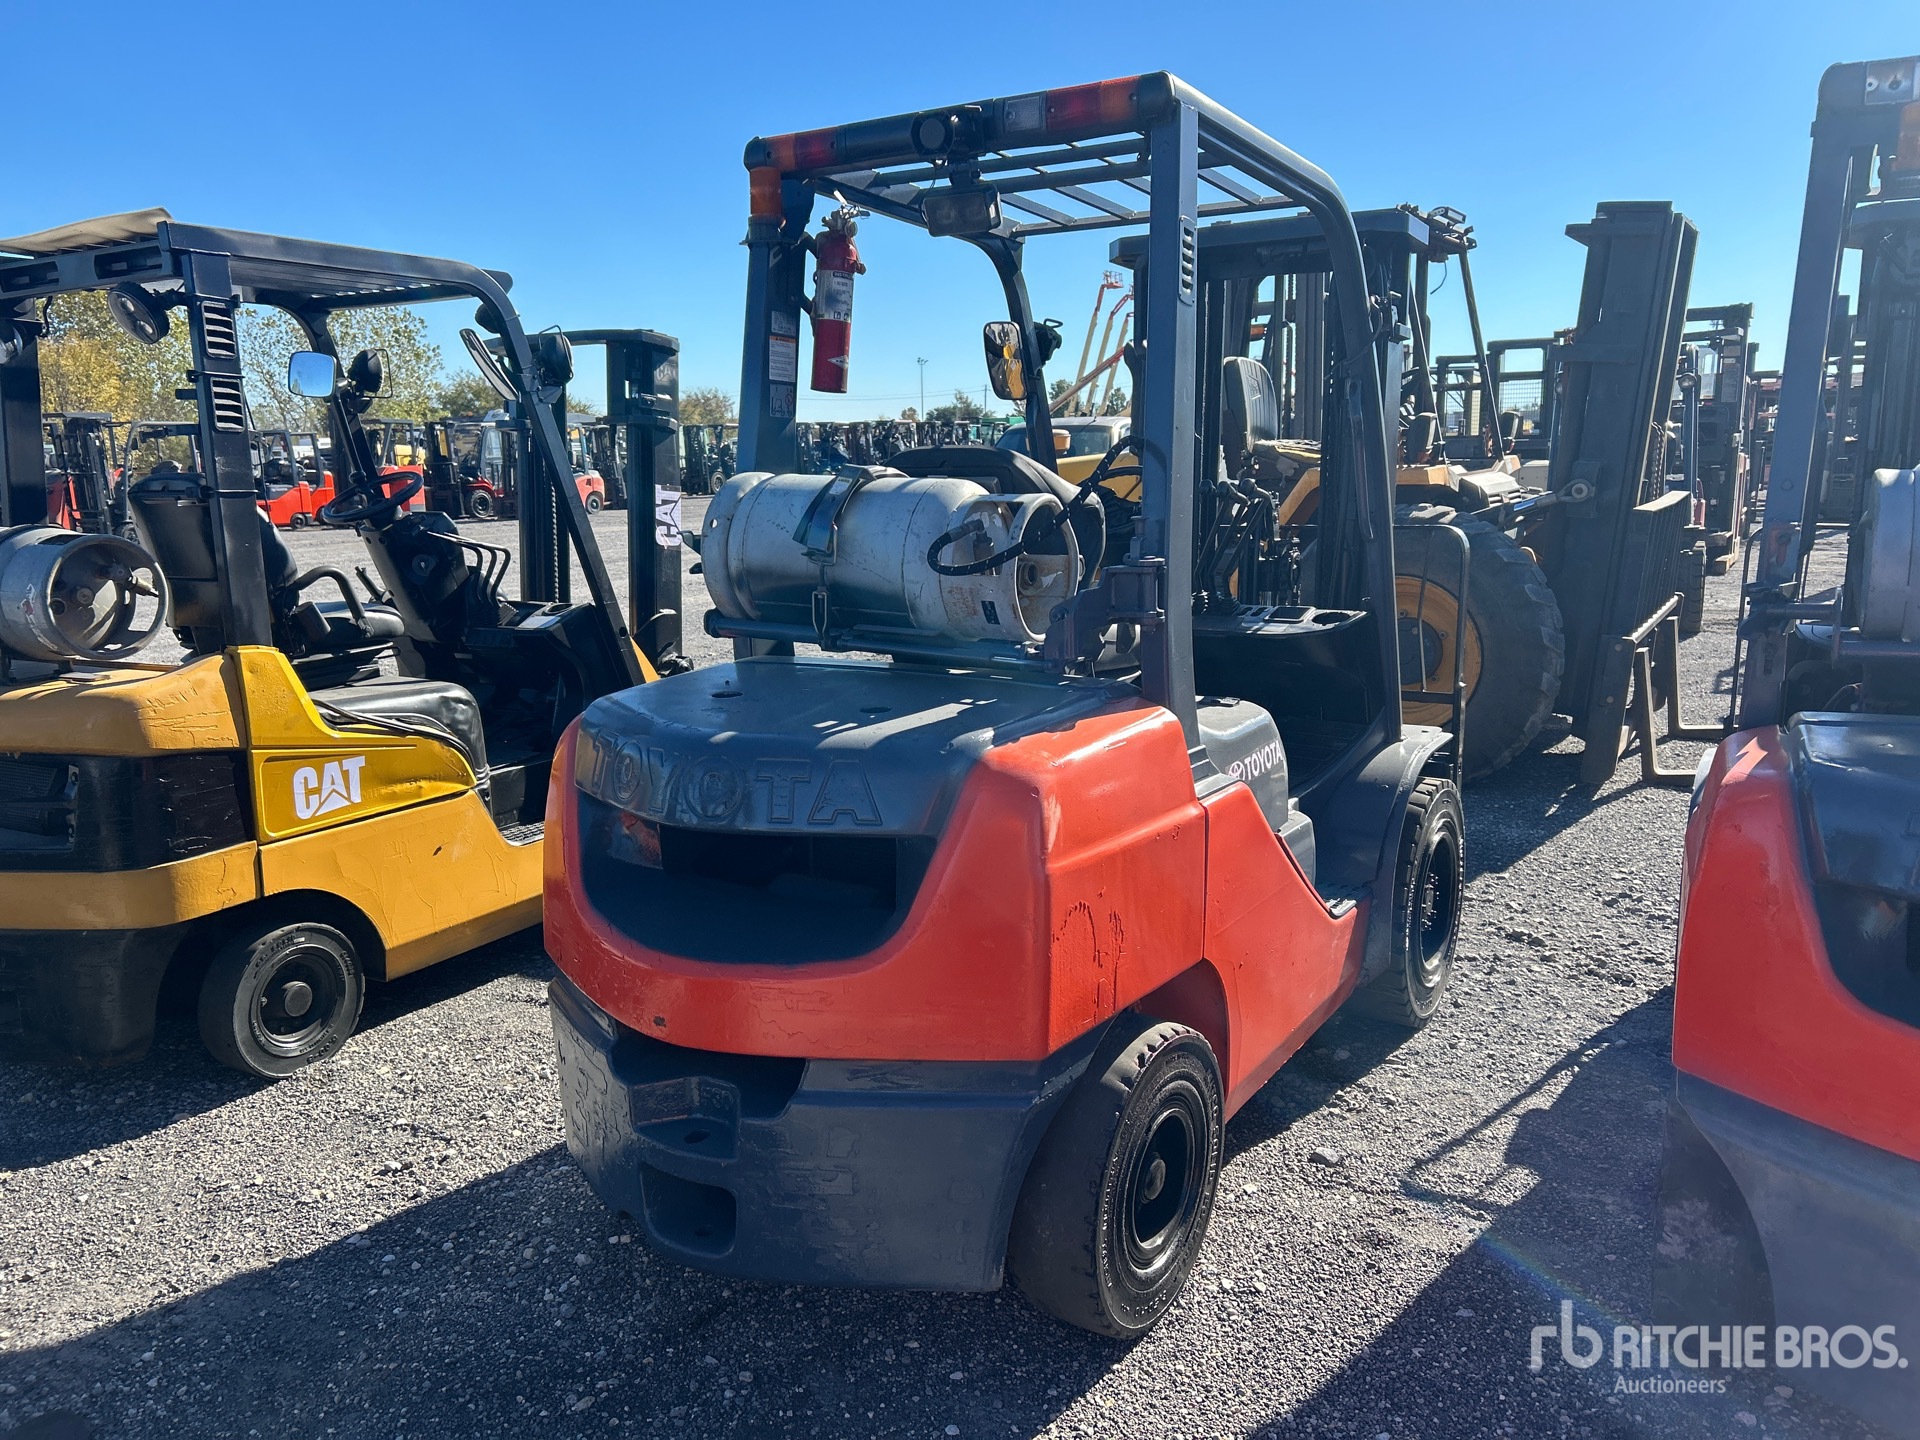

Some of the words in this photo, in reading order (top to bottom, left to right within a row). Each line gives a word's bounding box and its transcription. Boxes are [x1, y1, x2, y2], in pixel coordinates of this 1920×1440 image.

[655, 361, 676, 377] CAT
[655, 484, 683, 546] CAT
[293, 755, 366, 820] CAT
[593, 730, 883, 827] TOYOTA
[1244, 740, 1284, 780] TOYOTA
